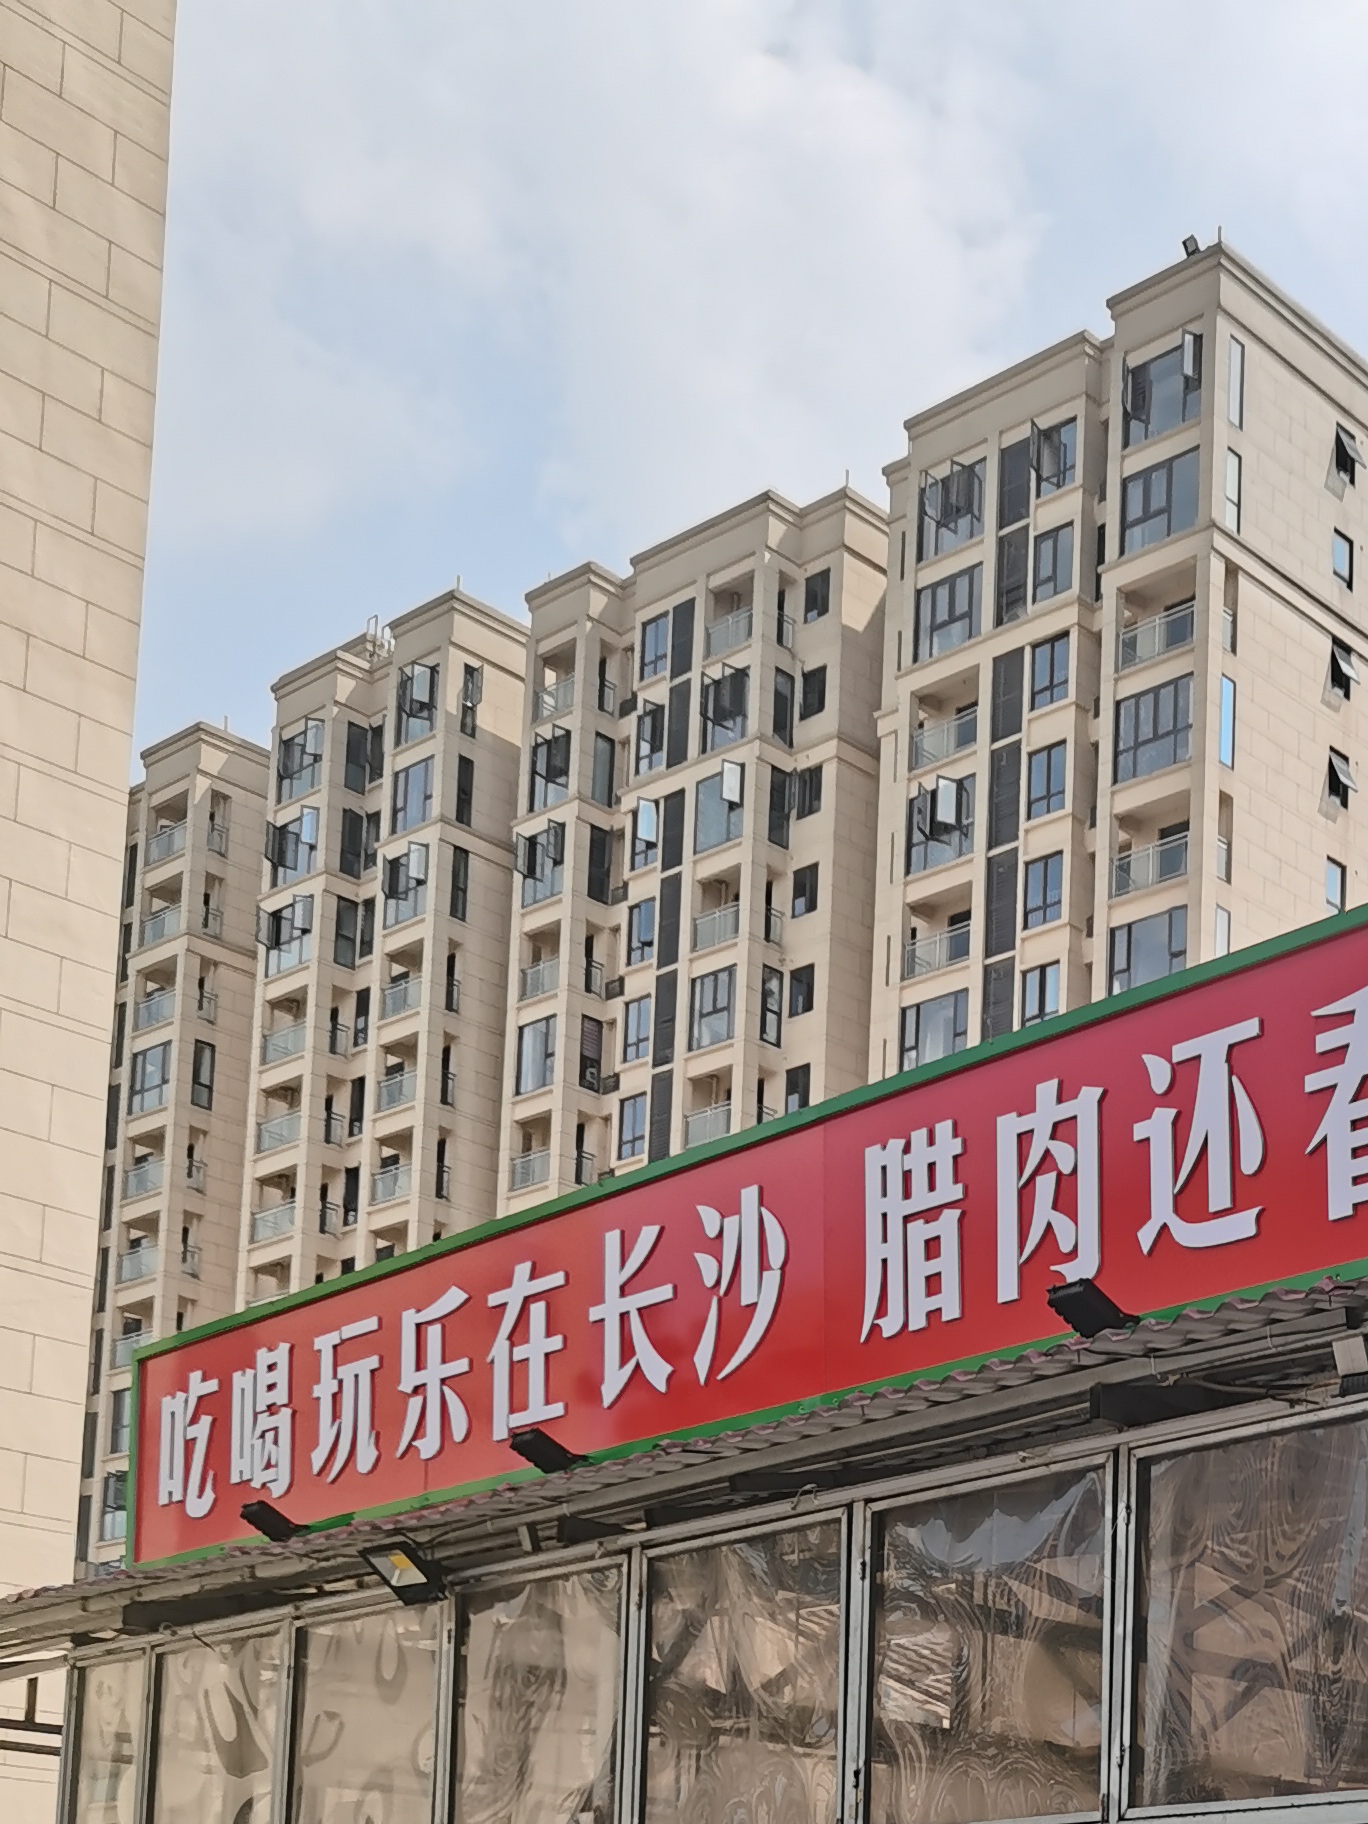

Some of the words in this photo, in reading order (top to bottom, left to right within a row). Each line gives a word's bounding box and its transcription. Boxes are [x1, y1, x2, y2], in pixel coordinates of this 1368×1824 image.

[157, 1184, 789, 1519] 吃喝玩乐在长沙
